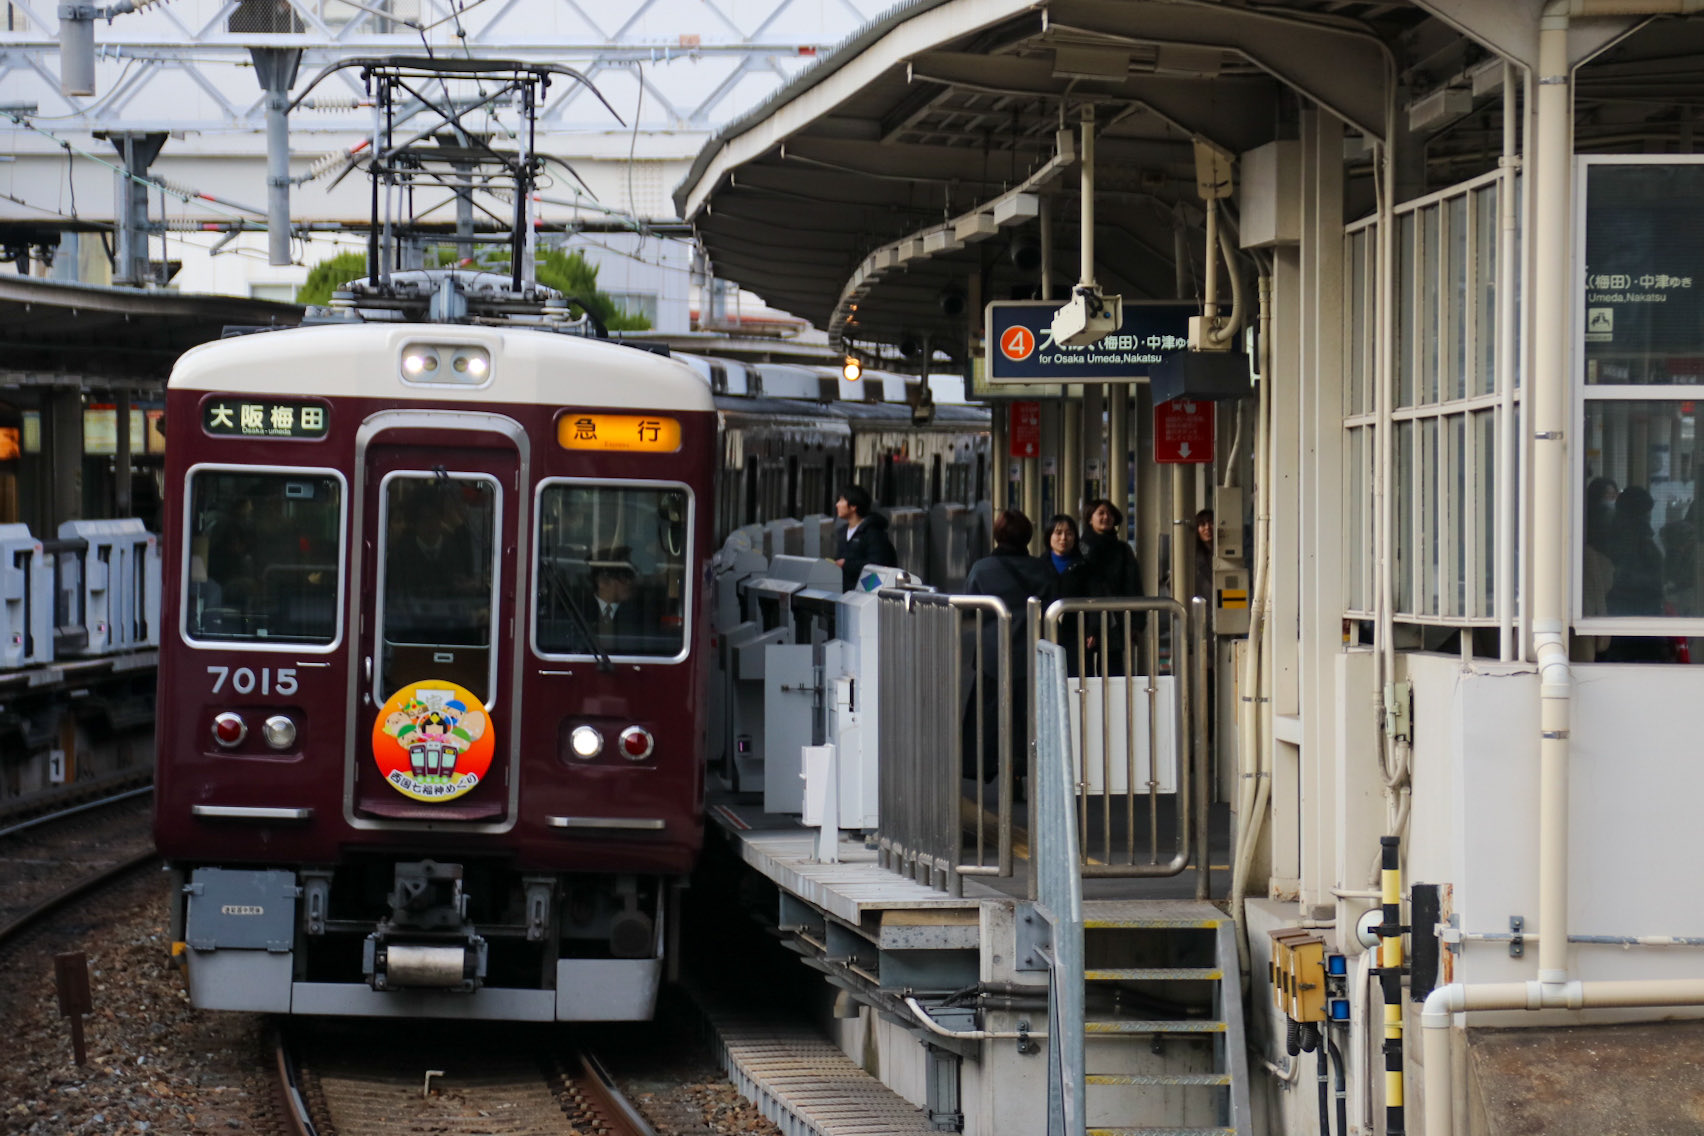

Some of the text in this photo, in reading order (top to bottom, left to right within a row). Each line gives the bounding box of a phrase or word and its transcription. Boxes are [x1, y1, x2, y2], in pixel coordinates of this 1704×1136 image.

[1008, 331, 1025, 355] 4
[1039, 354, 1052, 364] for
[1054, 354, 1085, 364] Osaka
[210, 403, 323, 430] 大阪梅田
[207, 666, 299, 696] 7015
[390, 772, 477, 795] 西国七福神めぐり
